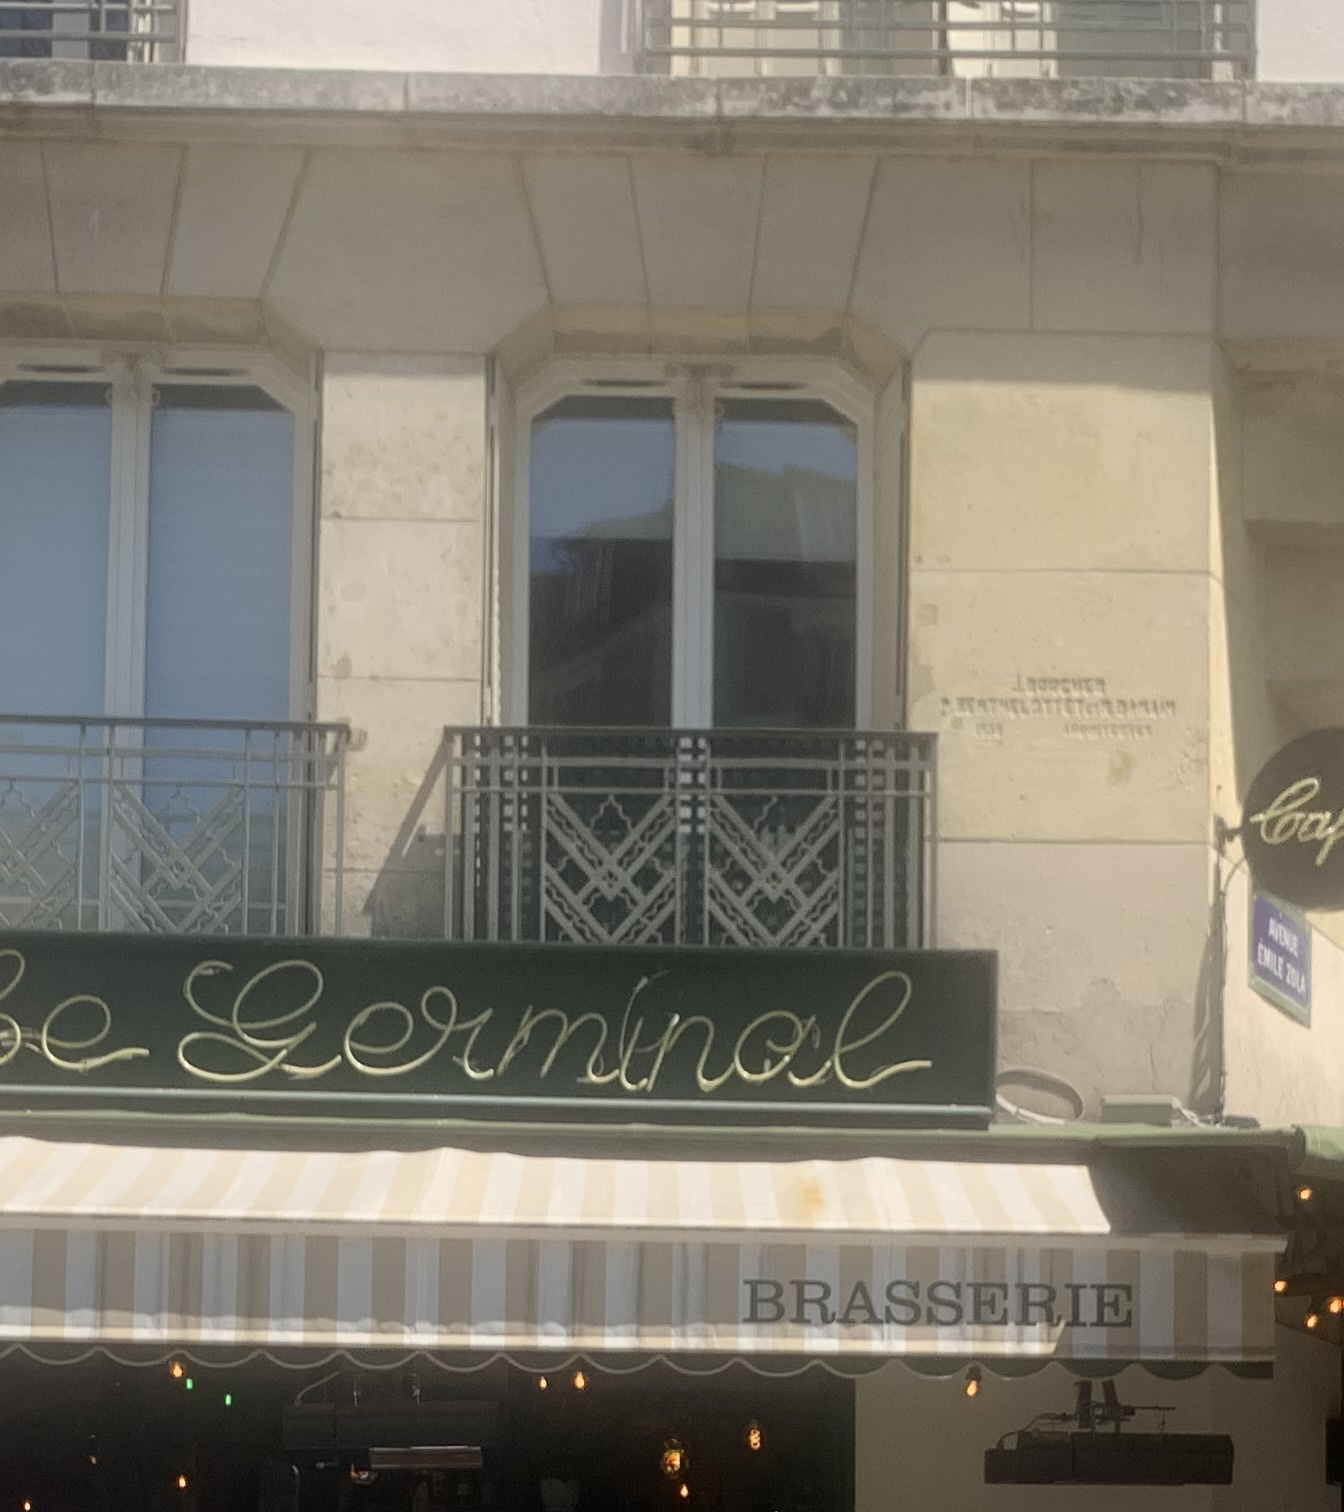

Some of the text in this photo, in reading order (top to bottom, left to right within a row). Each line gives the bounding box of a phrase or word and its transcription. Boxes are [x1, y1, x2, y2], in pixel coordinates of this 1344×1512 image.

[1268, 917, 1298, 958] AVENUE
[1285, 962, 1307, 994] ZOLA
[176, 959, 932, 1092] Germinal
[742, 1278, 1133, 1327] BRASSERIE
